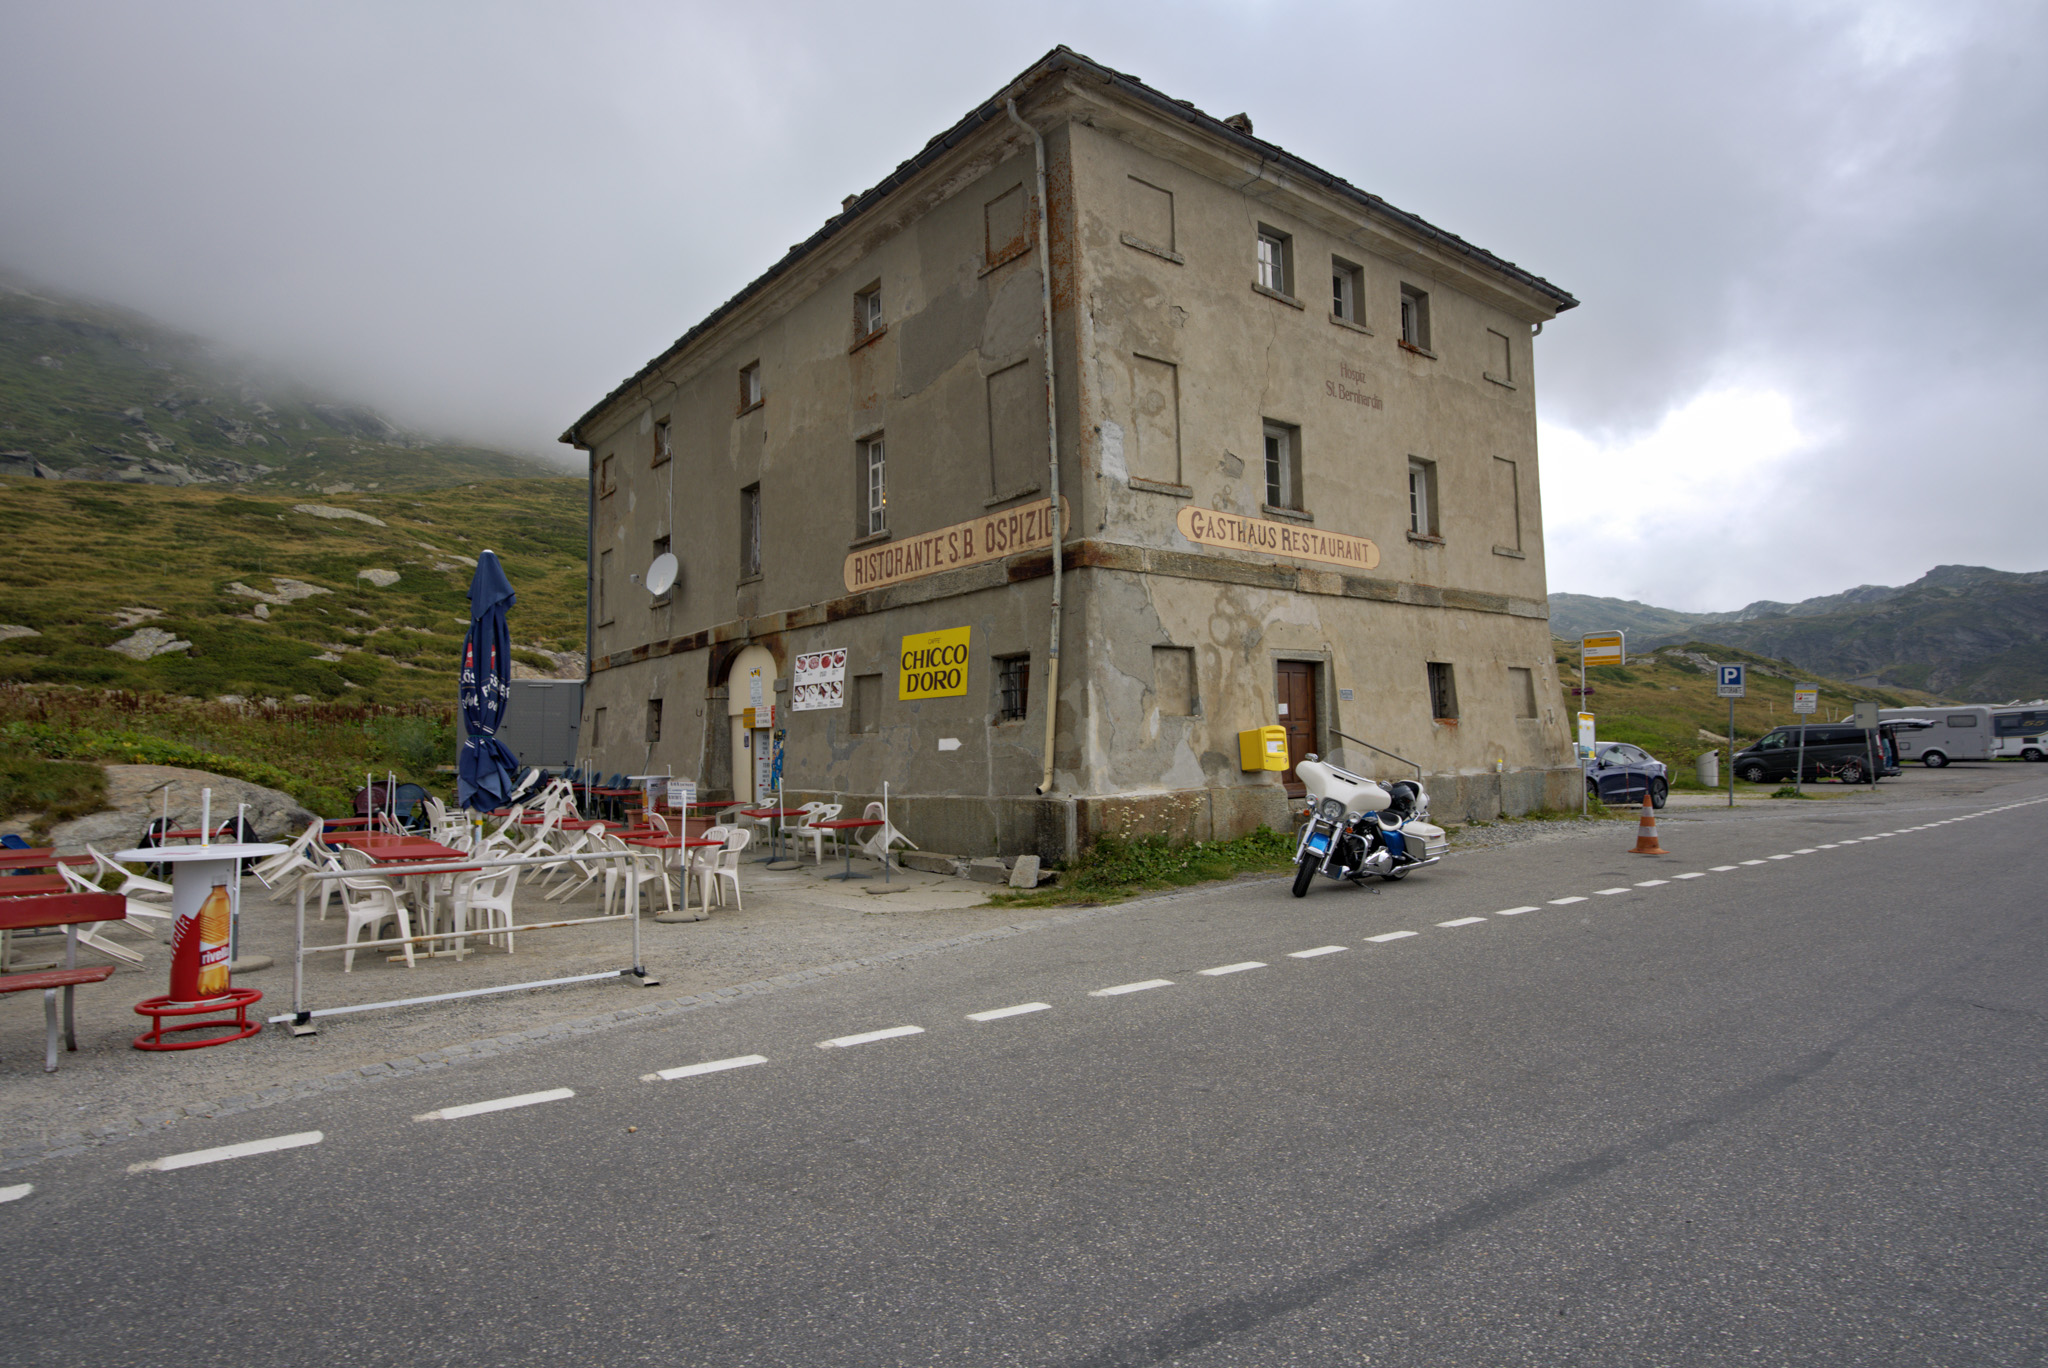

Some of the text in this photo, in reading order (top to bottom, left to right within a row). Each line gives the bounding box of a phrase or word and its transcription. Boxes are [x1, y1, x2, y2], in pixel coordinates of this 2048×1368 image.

[1340, 361, 1366, 385] Hospiz
[1339, 384, 1383, 411] Bernhardin
[1190, 511, 1369, 563] GASTHAUS RESTAURANT
[855, 536, 944, 585] RISTORANTE
[902, 644, 967, 671] CHICCO
[907, 668, 961, 693] D'ORO
[1724, 668, 1738, 684] P
